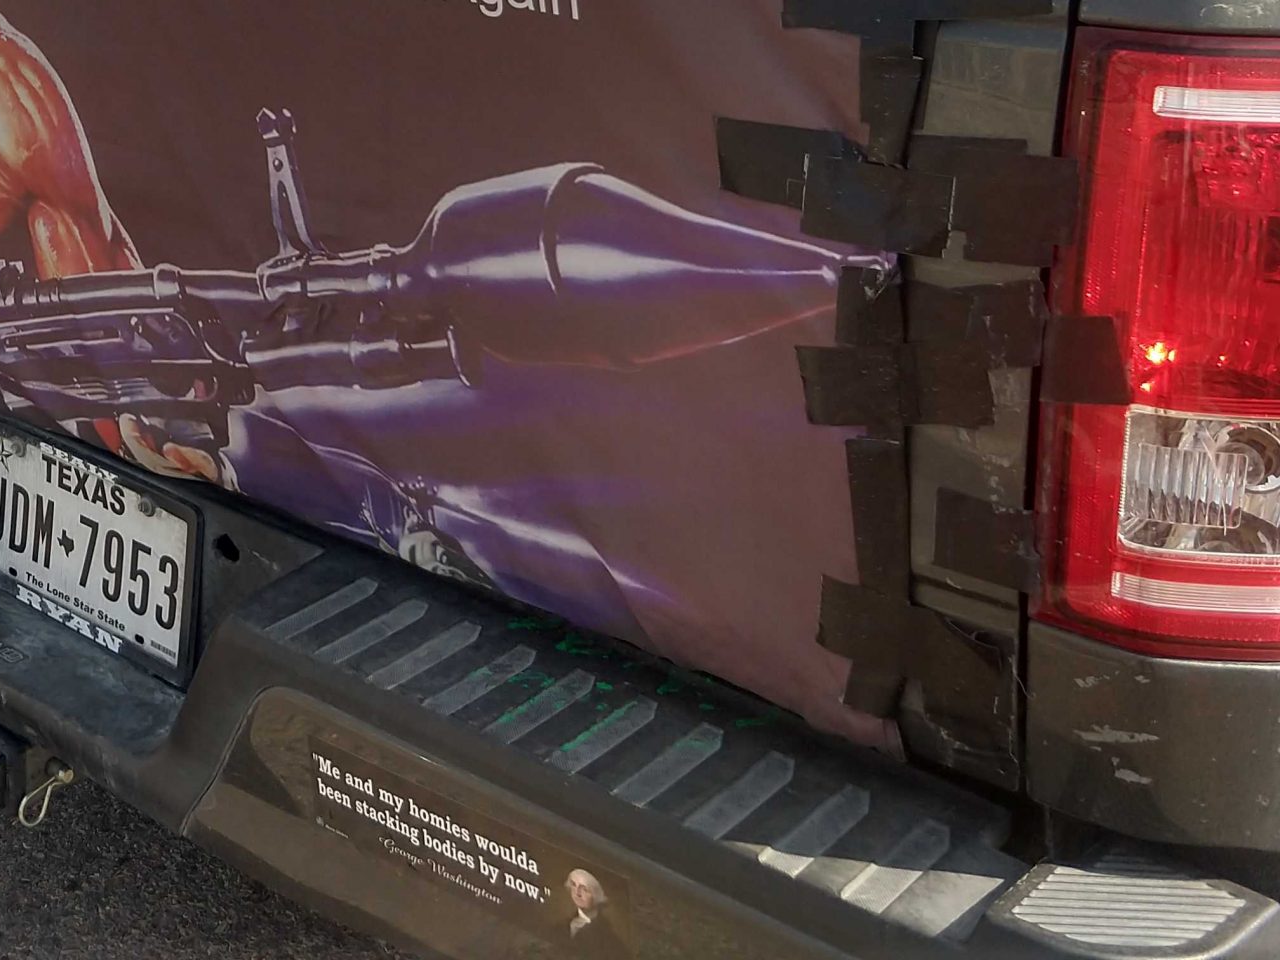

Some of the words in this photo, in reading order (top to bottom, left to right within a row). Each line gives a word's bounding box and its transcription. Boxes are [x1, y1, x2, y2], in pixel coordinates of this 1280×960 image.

[40, 453, 126, 516] TEXAS
[25, 571, 44, 589] The
[46, 579, 71, 603] Lone
[73, 596, 94, 616] Star
[97, 608, 125, 632] State
[79, 513, 179, 631] 7953
[16, 584, 122, 654] RYAN
[312, 752, 341, 780] "Me
[345, 772, 374, 797] and
[378, 788, 404, 814] my
[408, 798, 470, 842] homies
[474, 833, 540, 876] woulda
[317, 777, 352, 809] been
[355, 800, 420, 847] stacking
[423, 828, 475, 869] bodies
[479, 855, 500, 884] by
[504, 872, 551, 904] now."
[378, 836, 425, 866] George
[427, 857, 503, 905] Washington
